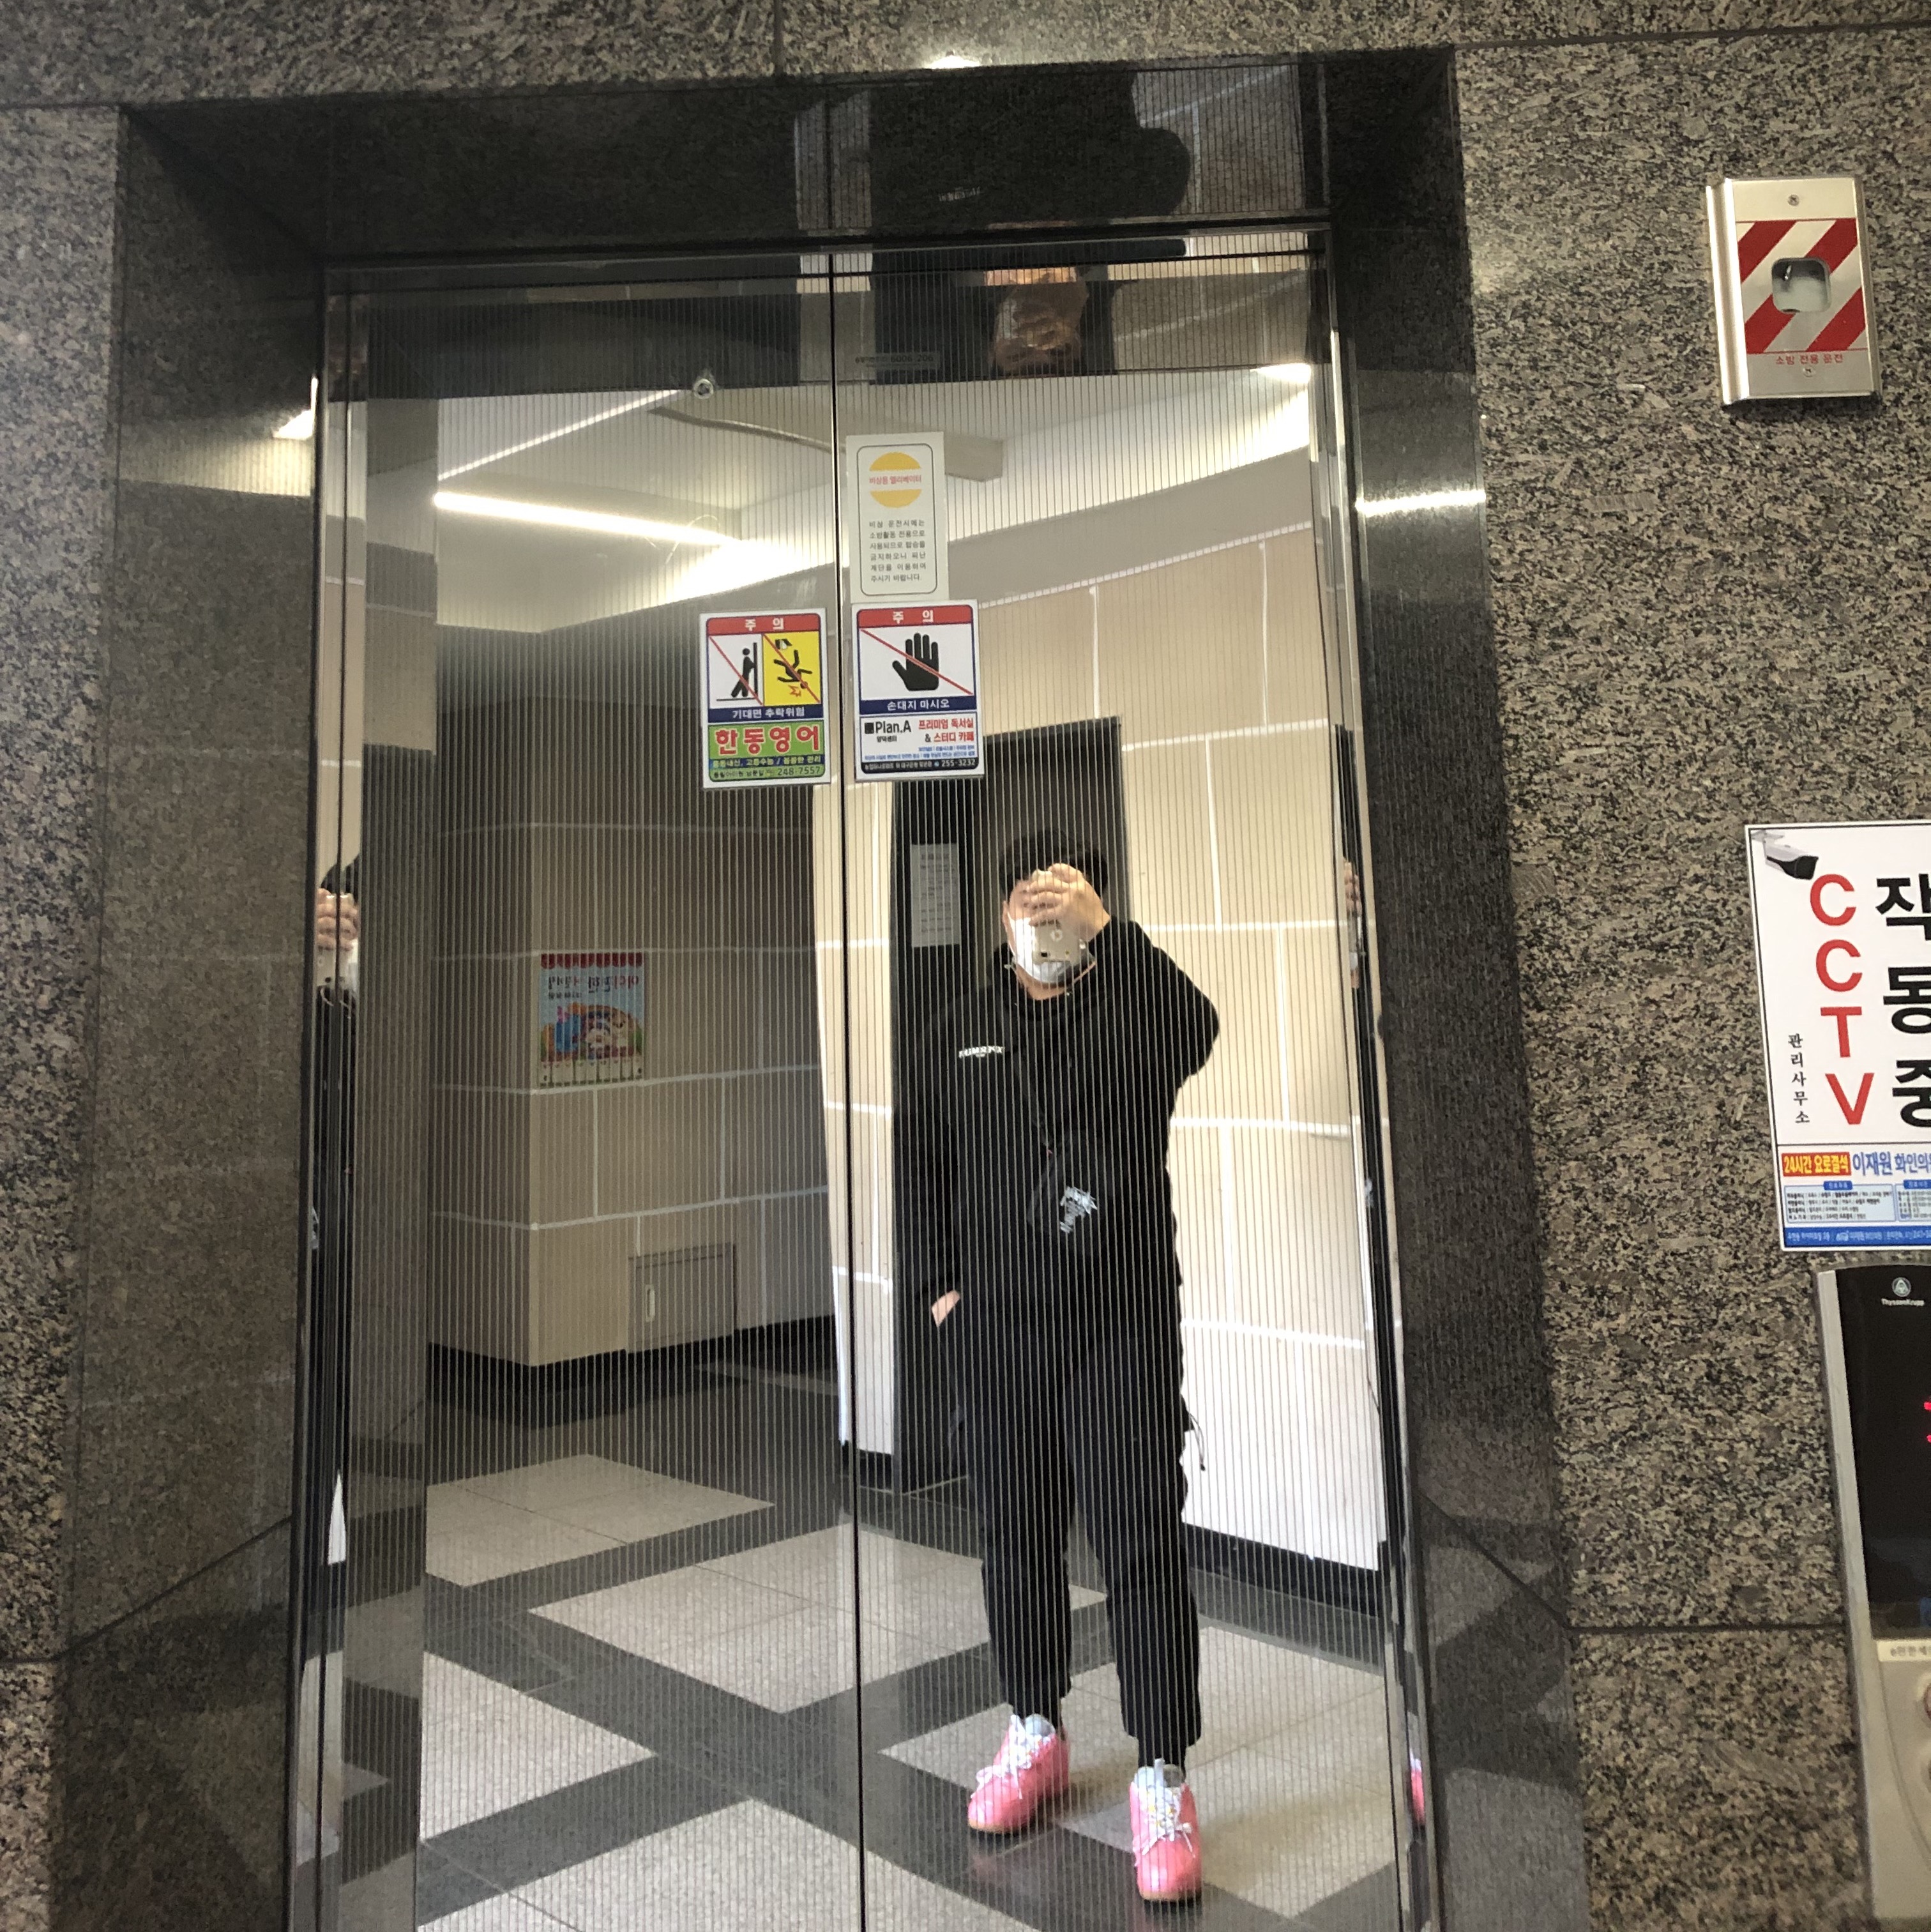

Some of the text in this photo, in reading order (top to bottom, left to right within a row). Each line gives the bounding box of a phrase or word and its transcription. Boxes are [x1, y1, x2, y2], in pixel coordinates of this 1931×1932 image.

[1776, 353, 1844, 365] 소방 전용 운전
[890, 474, 922, 484] 엘리베이터
[888, 519, 925, 528] 운전시에는
[898, 529, 925, 538] 전용으로
[870, 542, 904, 550] 사용되므로
[870, 552, 907, 561] 금지하오니
[871, 562, 926, 572] 계단을 이용하여
[887, 699, 950, 711] 손대지 마시오
[732, 706, 805, 719] 기대면 추락위험
[875, 720, 912, 734] Plan.A
[918, 718, 974, 730] 프리미엄 독서실
[715, 725, 820, 756] 한동영어
[925, 731, 974, 743] & 스터디 카페
[941, 758, 976, 767] 255-3232
[777, 765, 821, 776] 248-7557
[1810, 873, 1875, 1125] CCTV
[1788, 1033, 1810, 1123] 관리사무소
[1783, 1151, 1931, 1176] 24시간 요로결석 이재원 화인의
